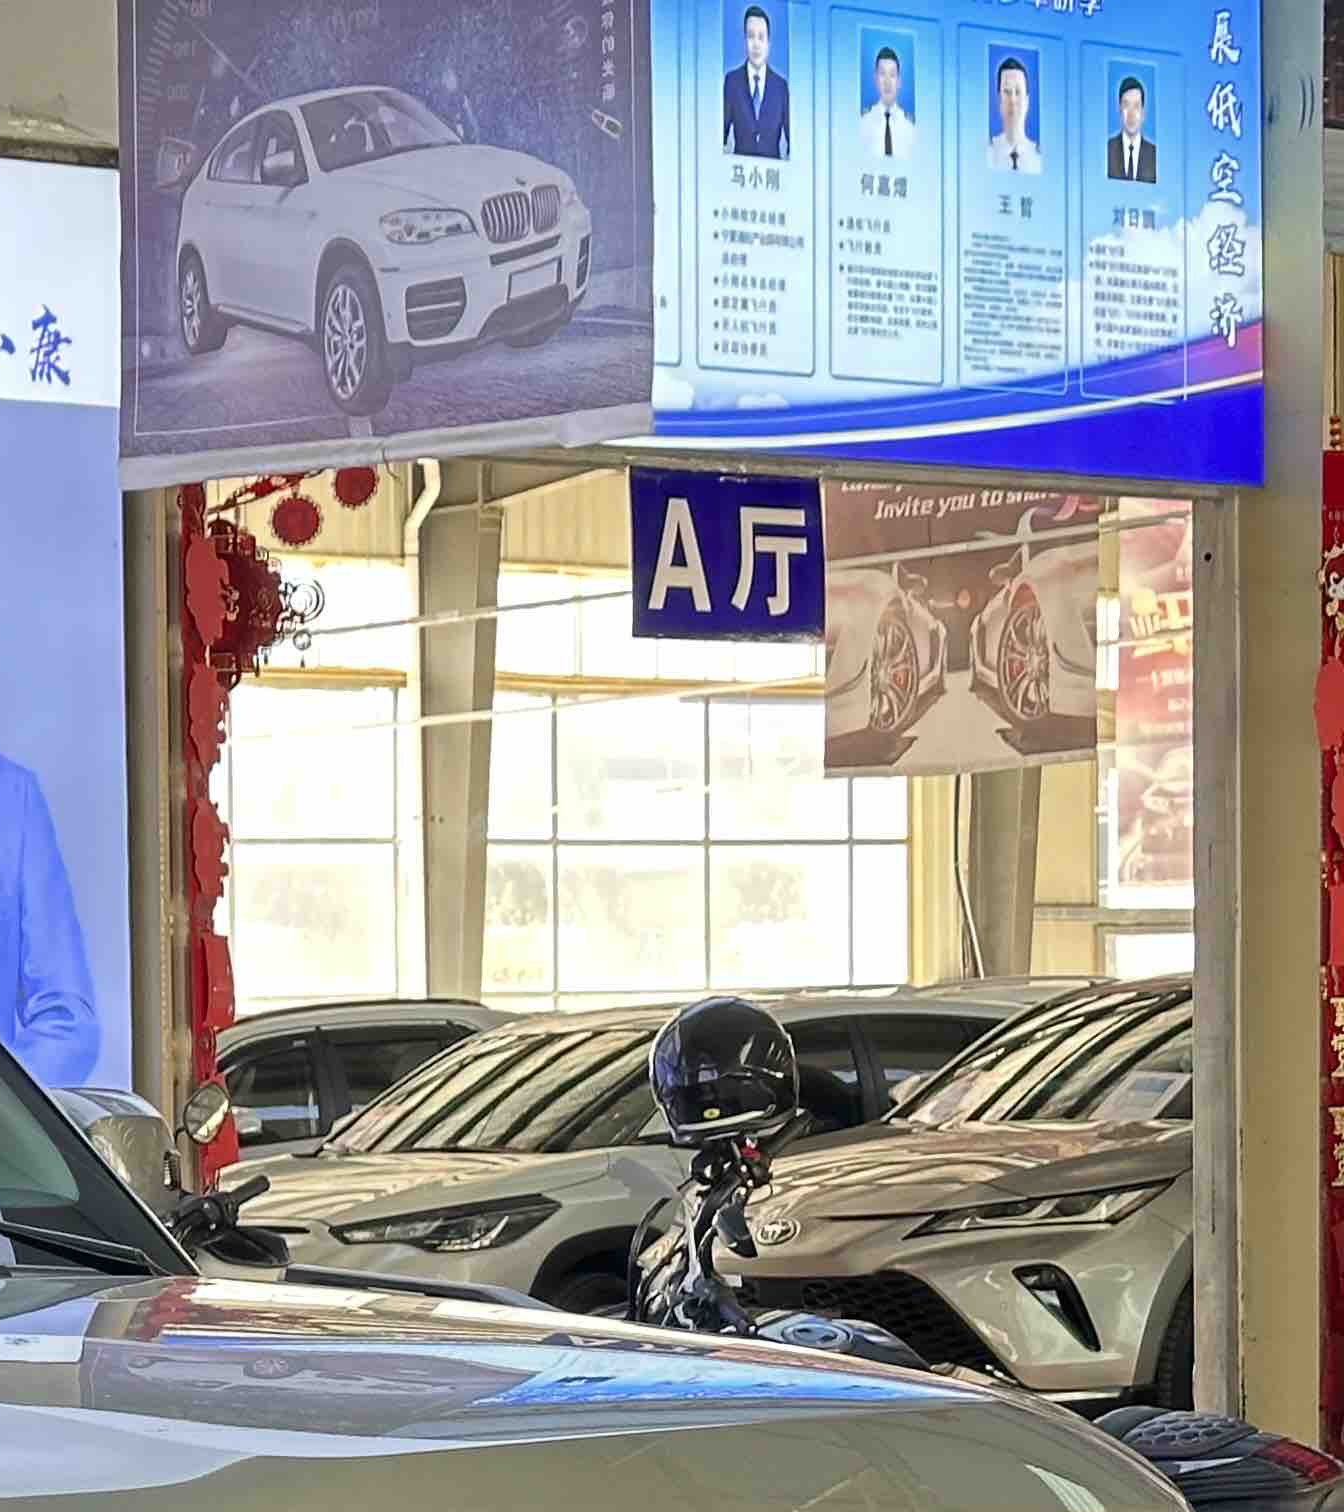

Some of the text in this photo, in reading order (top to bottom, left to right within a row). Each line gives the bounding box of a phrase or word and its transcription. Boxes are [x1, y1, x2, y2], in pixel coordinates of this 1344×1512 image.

[874, 495, 934, 520] Invite
[936, 492, 976, 518] you
[980, 489, 1004, 507] to
[647, 498, 808, 617] A厅
